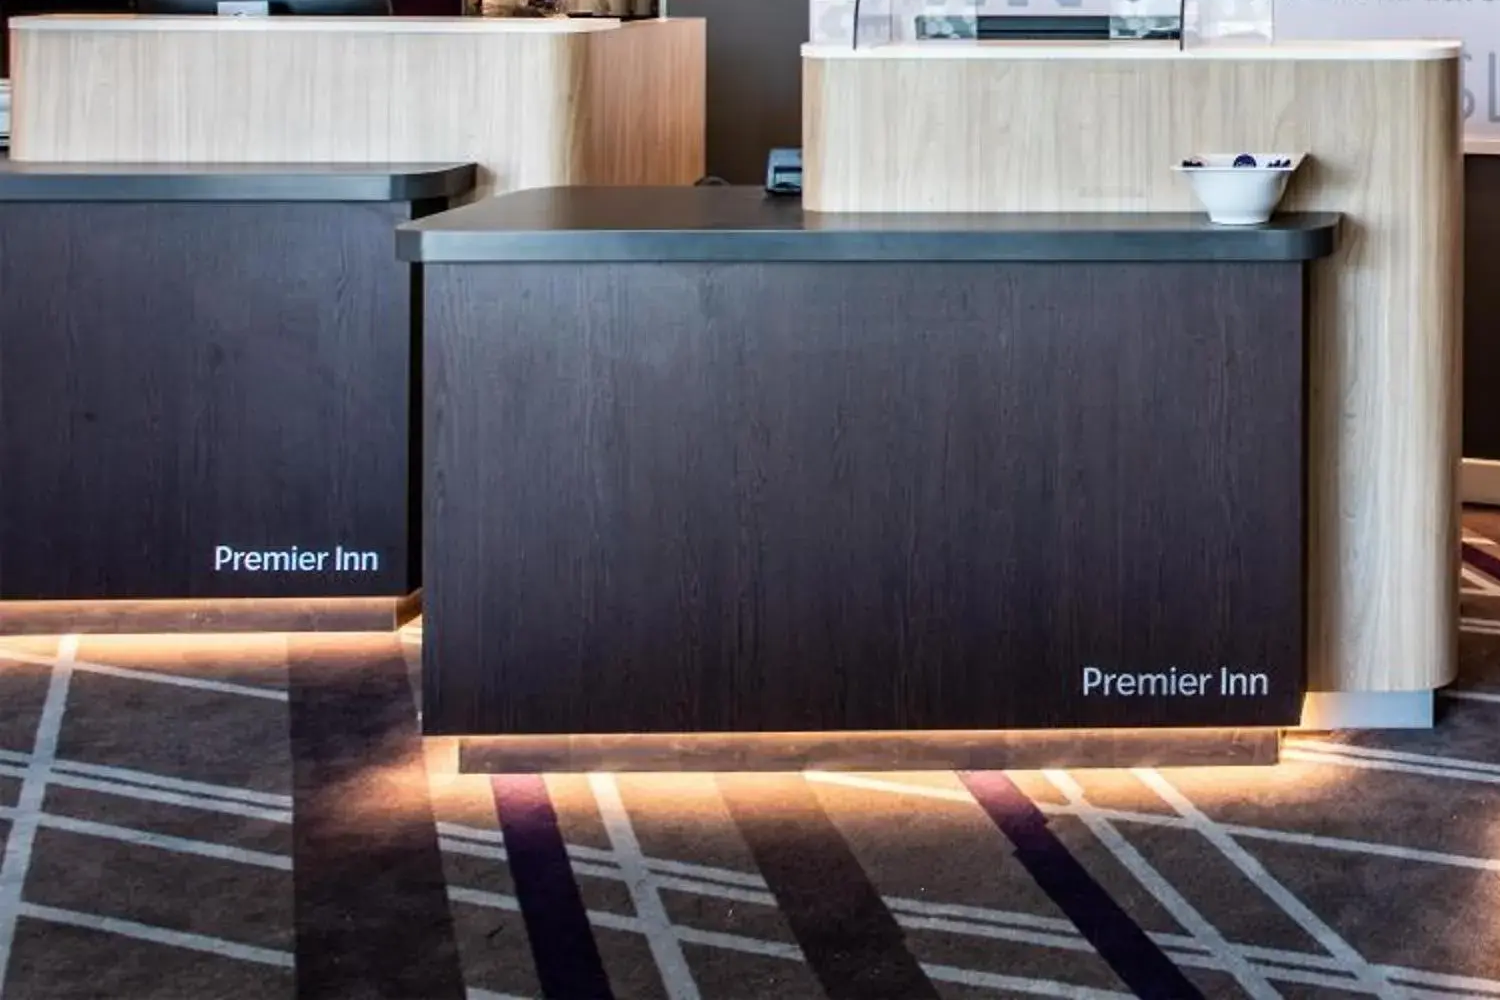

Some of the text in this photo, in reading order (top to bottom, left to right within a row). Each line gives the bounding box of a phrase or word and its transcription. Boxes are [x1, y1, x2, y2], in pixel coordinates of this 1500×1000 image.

[214, 545, 379, 571] Premier Inn
[1082, 666, 1269, 696] Premier Inn
